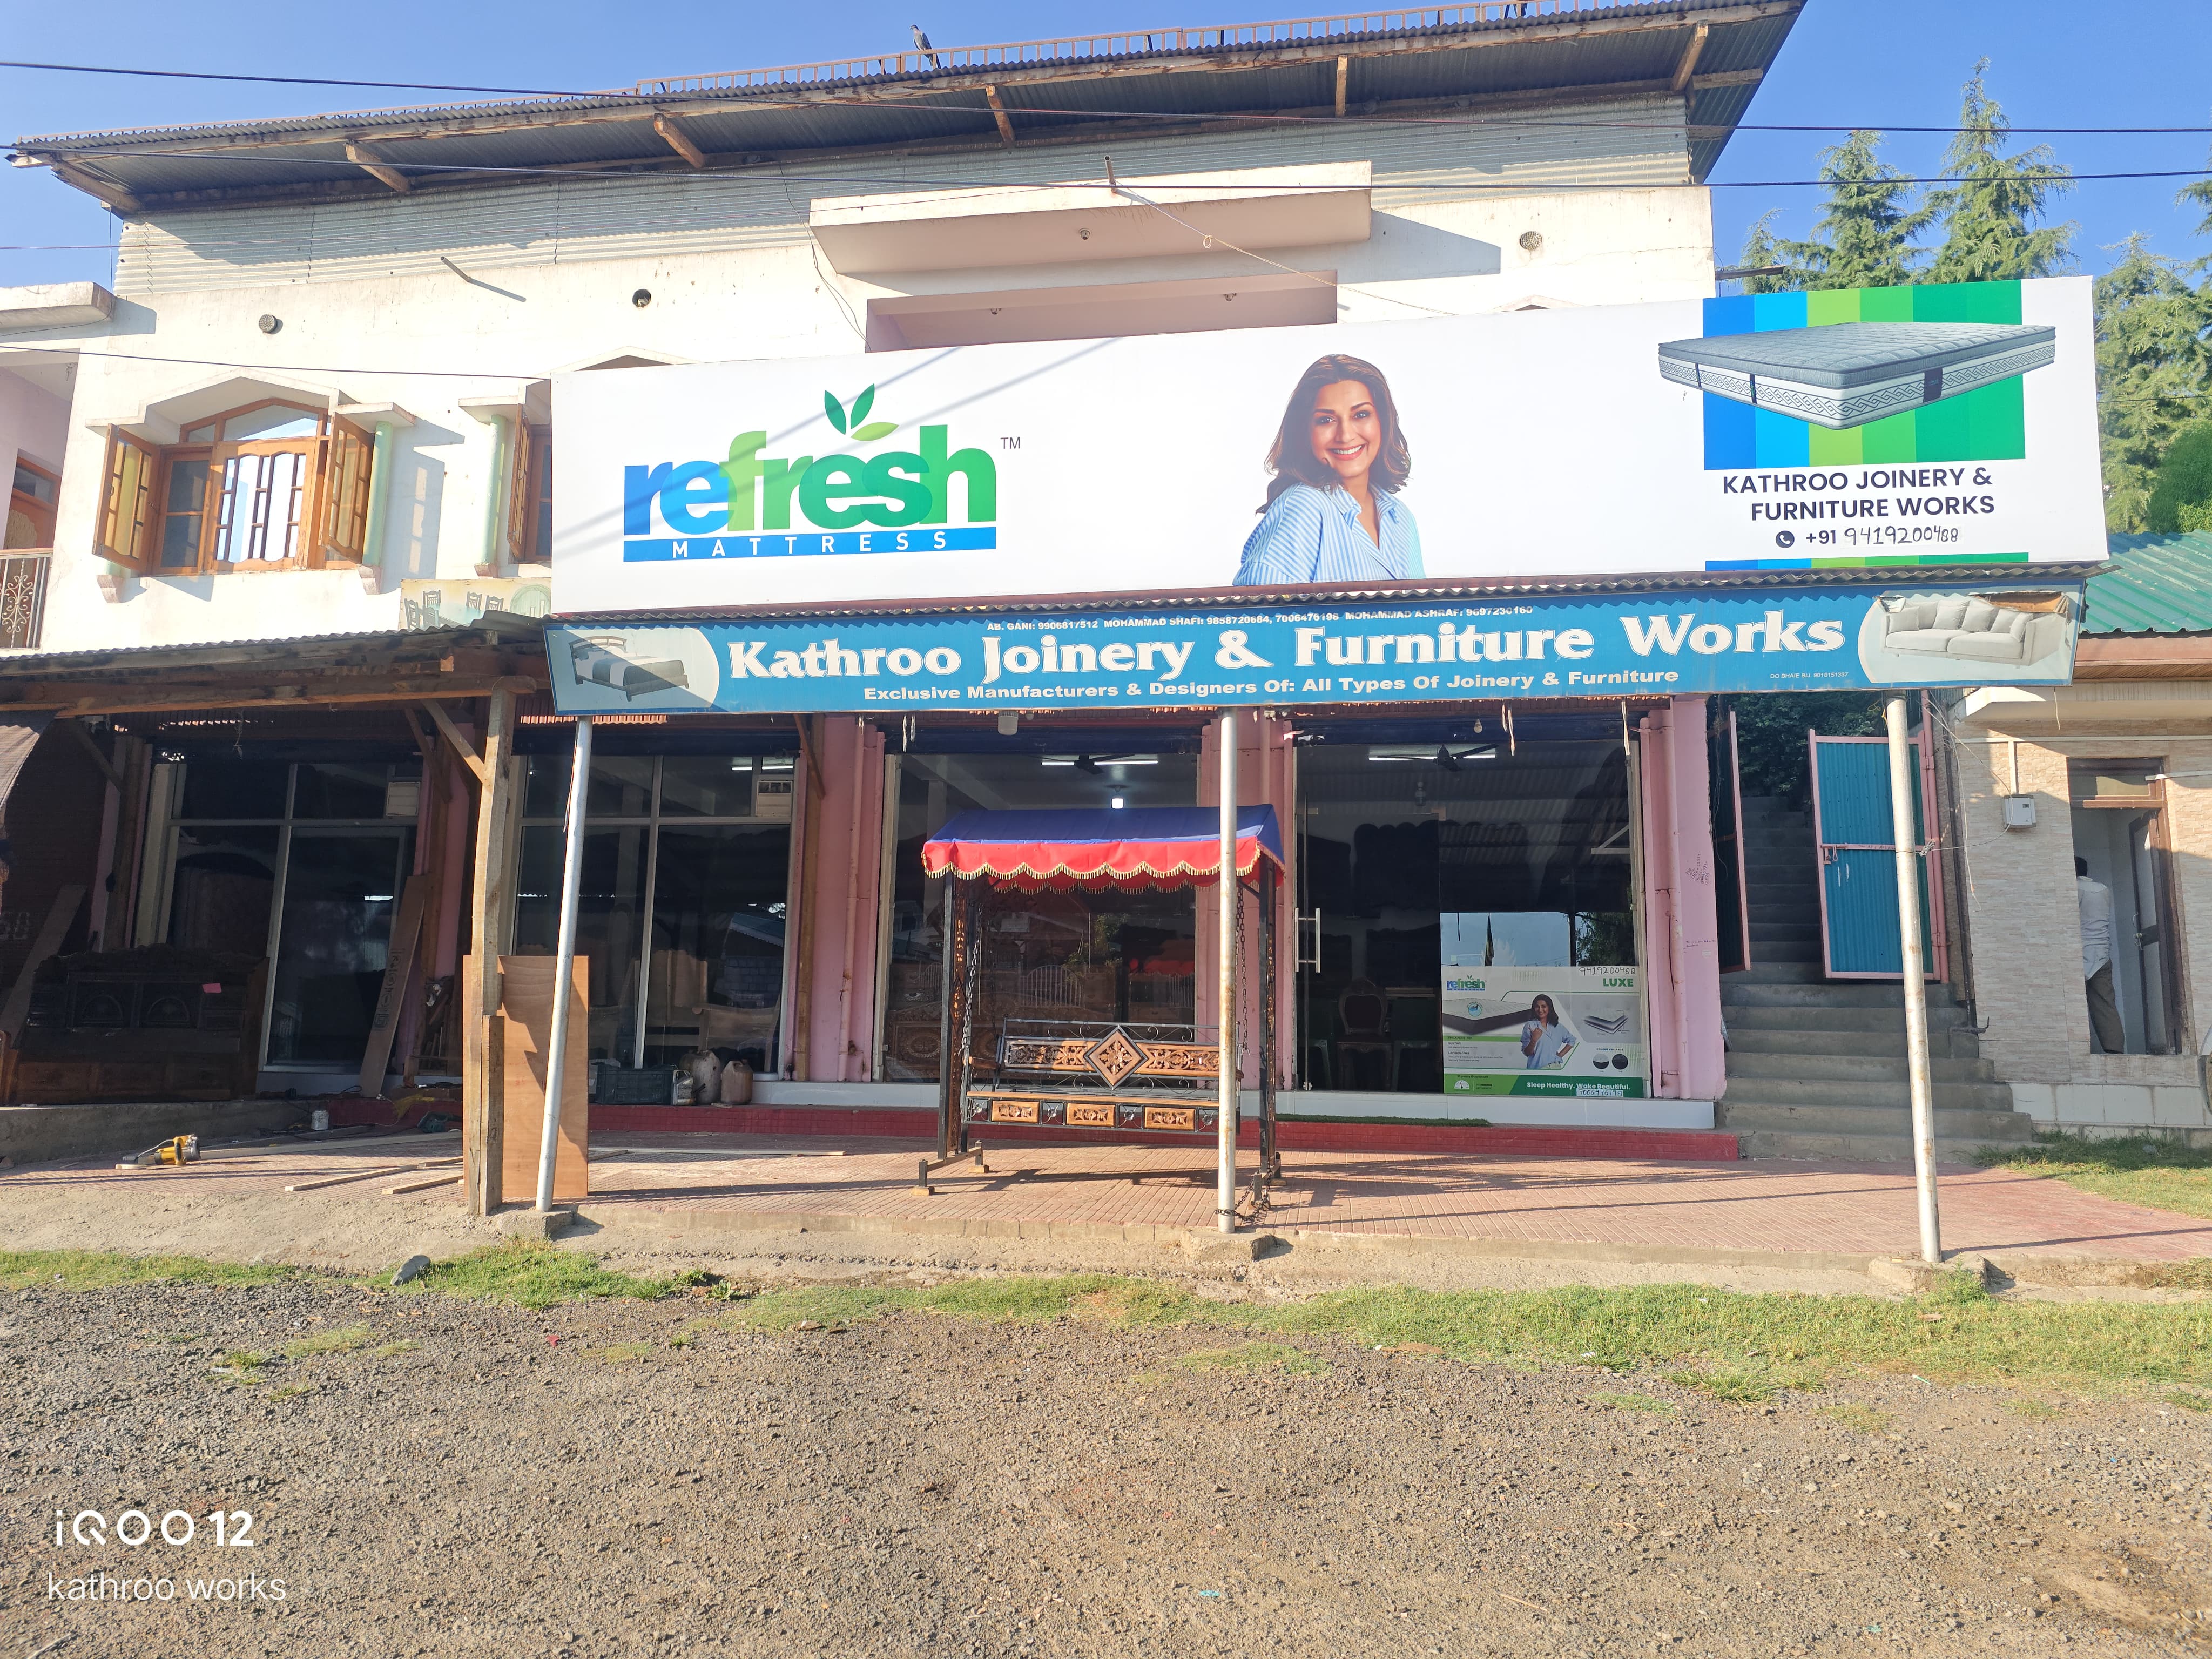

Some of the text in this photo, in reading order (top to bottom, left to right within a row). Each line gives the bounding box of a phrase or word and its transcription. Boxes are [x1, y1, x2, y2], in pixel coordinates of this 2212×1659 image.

[1000, 437, 1021, 450] TM
[624, 424, 996, 535] refresh
[1723, 467, 1993, 494] KATHROO JOINERY &
[1751, 496, 1995, 521] FURNITURE WORKS
[672, 531, 946, 558] MATTRESS
[1806, 525, 1958, 545] +91 9419200488
[987, 622, 1004, 631] AB.
[1007, 622, 1035, 630] GANI:
[1038, 621, 1098, 630] 9906817512
[1104, 617, 1166, 628] MOHAMMAD
[1169, 616, 1204, 625] SHAFI:
[1206, 615, 1272, 625] 9858720684,
[1275, 612, 1339, 622] 7006476198
[1345, 610, 1412, 620] MOHAMMAD
[1414, 609, 1463, 617] ASHRAF:
[727, 609, 1845, 685] Kathroo Joinery & Furniture Works
[865, 669, 1679, 701] Exclusive Manufacturers & Designers Of: All Types Of Joinery & Furniture
[1447, 978, 1485, 988] refresh
[1579, 967, 1636, 976] 9419200488
[1603, 978, 1634, 987] LUXE
